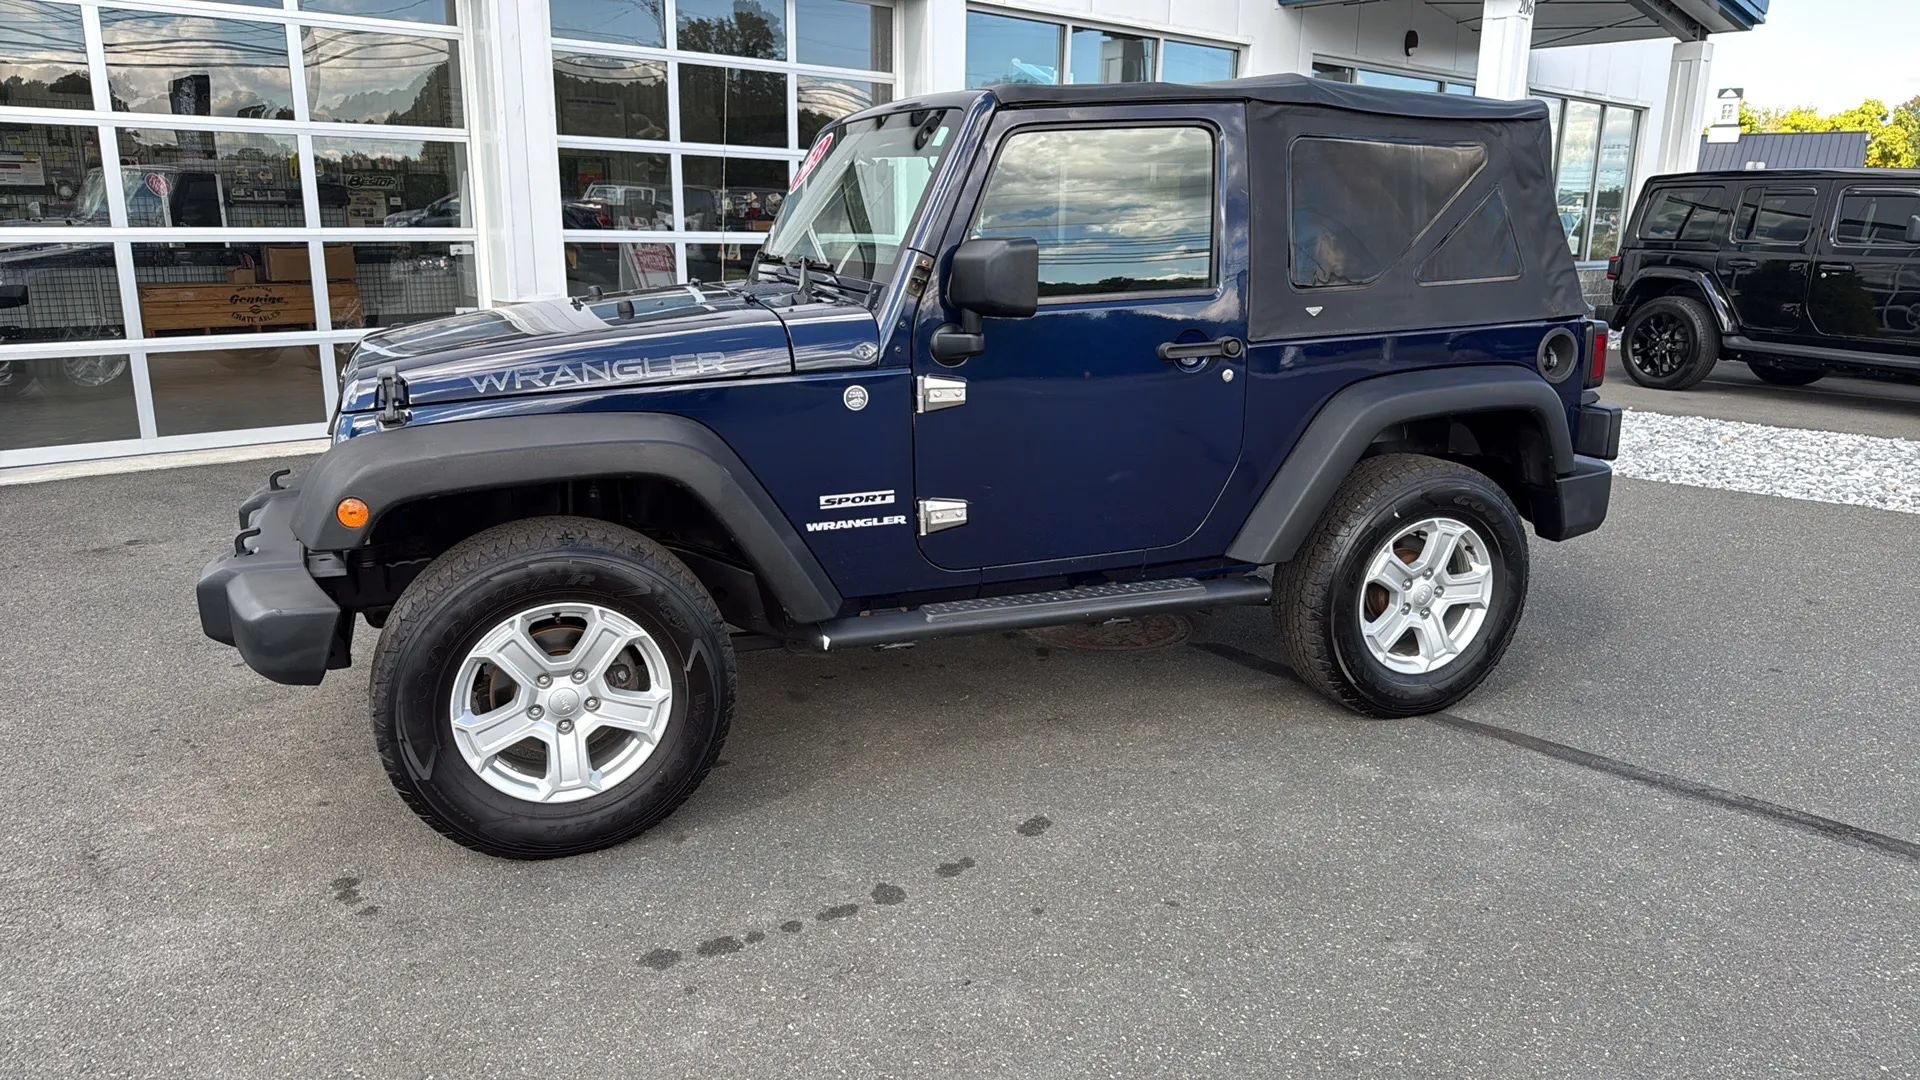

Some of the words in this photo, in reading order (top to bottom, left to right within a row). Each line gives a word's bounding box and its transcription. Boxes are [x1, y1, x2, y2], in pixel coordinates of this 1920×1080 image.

[469, 352, 728, 394] WRANGLER
[820, 494, 894, 506] SPORT
[806, 515, 907, 532] WRANGLER
